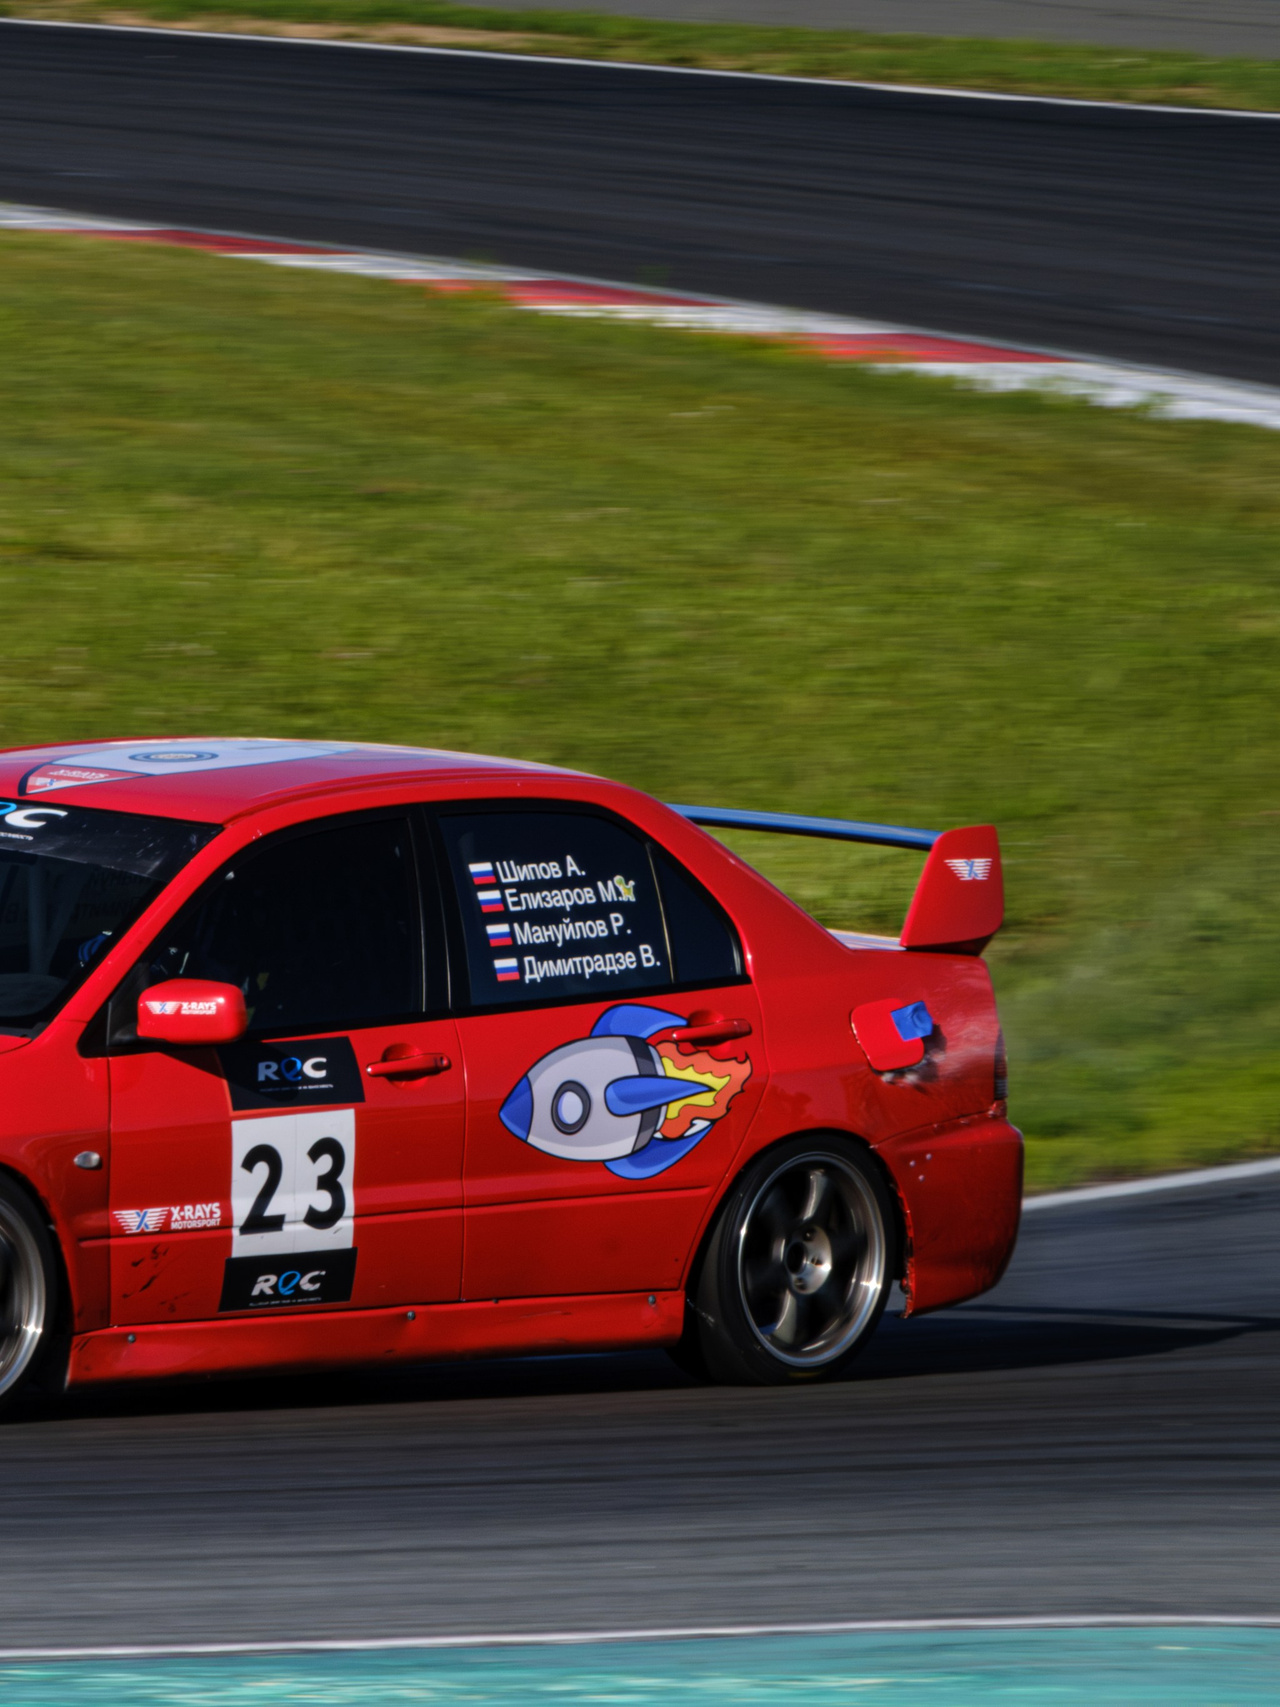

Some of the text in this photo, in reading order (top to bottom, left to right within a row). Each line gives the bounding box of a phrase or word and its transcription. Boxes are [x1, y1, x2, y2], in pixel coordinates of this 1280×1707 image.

[496, 855, 586, 883] Шипов А.
[505, 887, 596, 911] Елизаров
[513, 913, 632, 947] Мануйлов Р.
[523, 944, 661, 984] Димитрадзе В.
[181, 1002, 217, 1010] X-RAYS
[239, 1137, 346, 1236] 23
[171, 1202, 221, 1221] X-RAYS
[171, 1218, 221, 1230] MOTORSPORT
